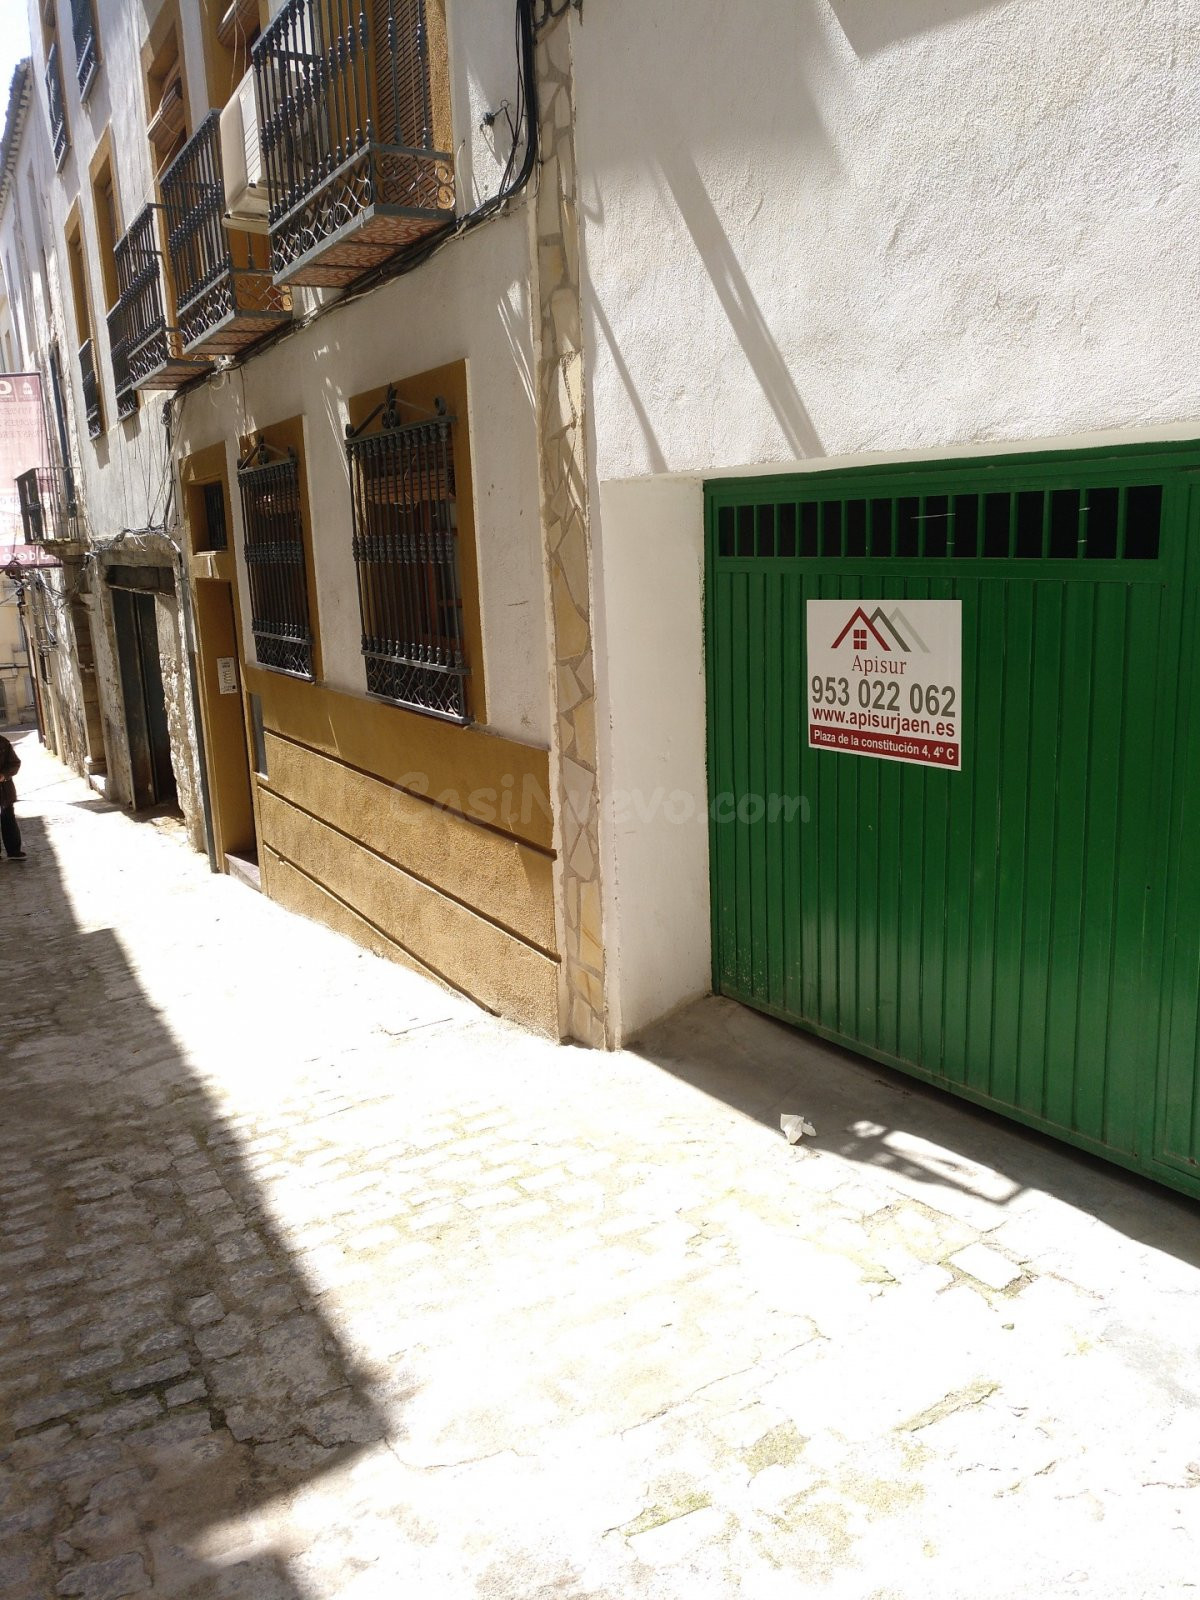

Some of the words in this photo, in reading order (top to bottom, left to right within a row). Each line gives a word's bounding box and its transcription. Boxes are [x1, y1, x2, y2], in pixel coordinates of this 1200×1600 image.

[852, 655, 907, 676] Apisur
[811, 675, 850, 706] 953
[858, 679, 900, 711] 022
[909, 683, 956, 718] 062
[812, 707, 955, 737] www.apisurjaen.es
[814, 730, 836, 743] Plaza
[838, 733, 849, 745] de
[850, 735, 859, 746] la
[861, 737, 920, 755] constitución
[921, 745, 931, 759] 4,
[946, 748, 955, 760] C
